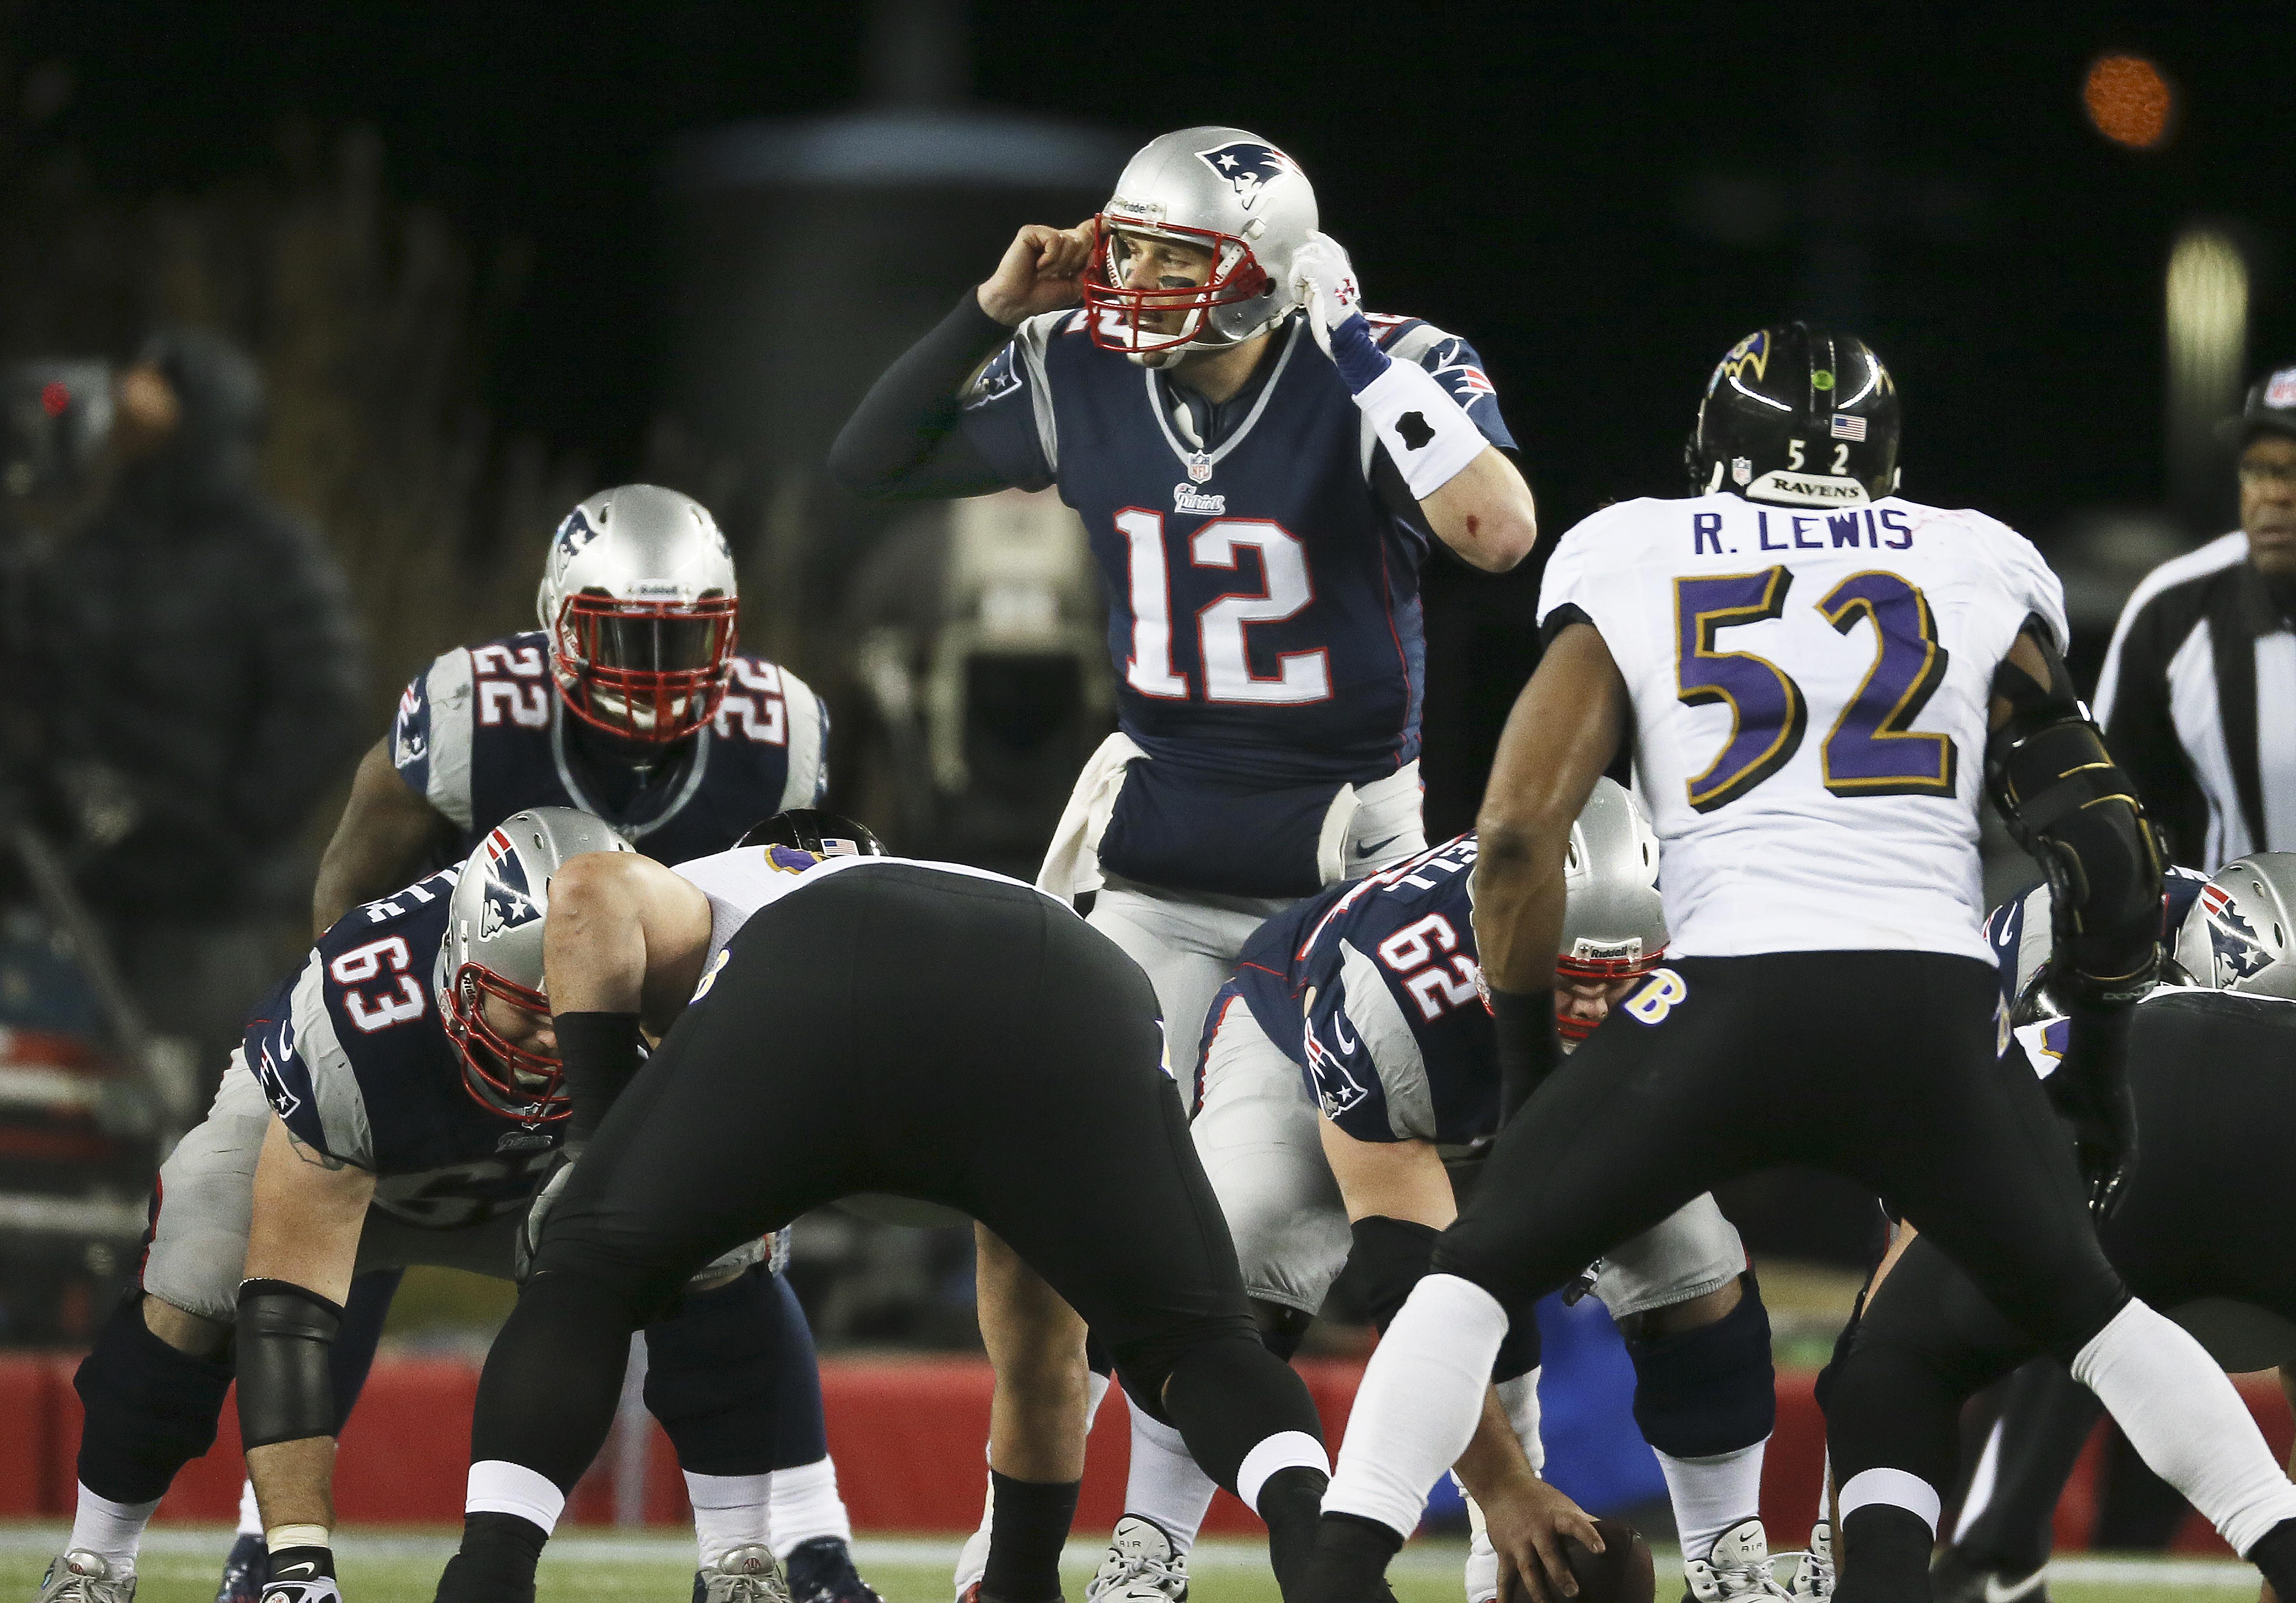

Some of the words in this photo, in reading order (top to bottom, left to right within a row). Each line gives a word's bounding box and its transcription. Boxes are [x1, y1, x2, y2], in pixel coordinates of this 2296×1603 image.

[1772, 477, 1859, 498] RAVENS
[1693, 513, 1738, 555] R.
[1758, 509, 1914, 552] LEWIS
[1113, 506, 1334, 707] 12
[470, 642, 551, 730] 22
[713, 656, 787, 747] 22
[1672, 564, 1958, 814] 52
[1382, 834, 1479, 892] ELL
[329, 934, 429, 1035] 63
[1377, 911, 1478, 1024] 62
[1590, 945, 1628, 958] Riddell
[1741, 1542, 1763, 1553] AIR
